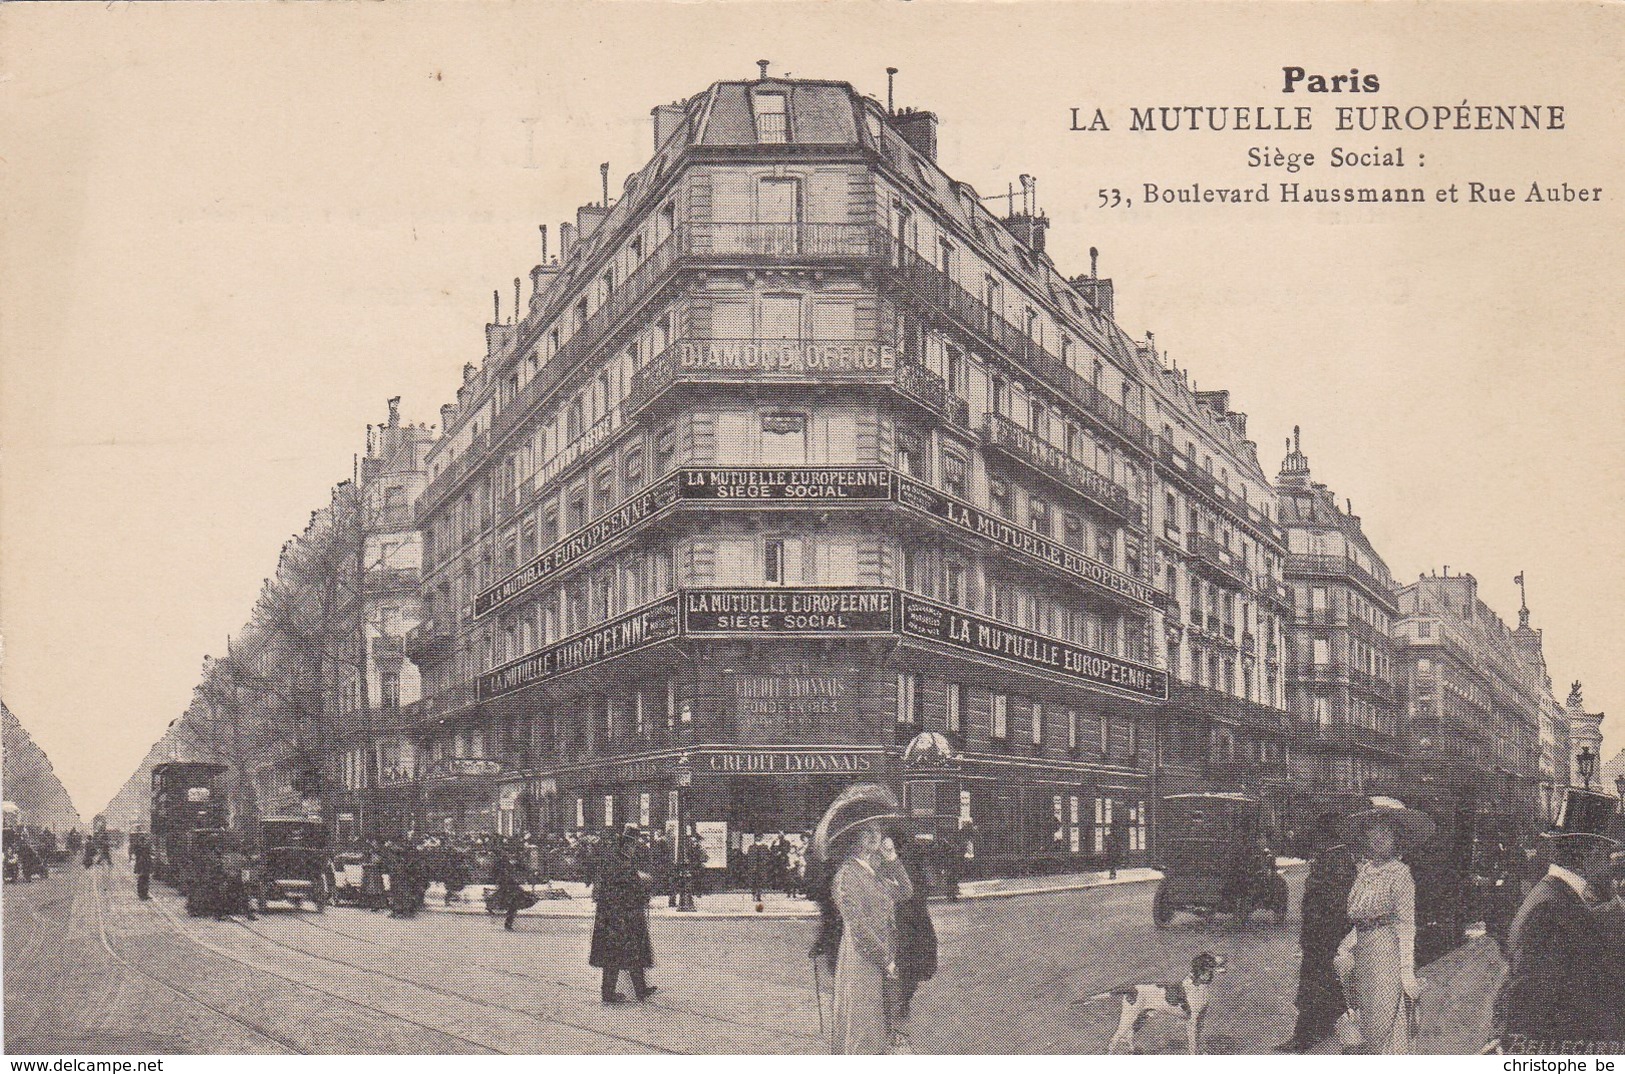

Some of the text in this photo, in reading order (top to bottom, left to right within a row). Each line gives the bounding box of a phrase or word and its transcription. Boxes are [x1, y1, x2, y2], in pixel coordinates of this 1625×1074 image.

[805, 345, 895, 370] OFFICE
[687, 471, 889, 486] LA MUTUELLE EUROPEENNE
[717, 485, 848, 497] SIEGE SOCIAL
[555, 494, 652, 568] EUROPEENNE
[947, 502, 1154, 605] LA MUTUELLE EUROPEENNE
[689, 594, 889, 612] LA MUTUELLE EUROPEENNE
[717, 615, 847, 628] SIEGE SOCIAL
[950, 615, 971, 643] LA
[978, 624, 1060, 666] MUTUELLE
[1064, 649, 1152, 691] EUROPEENNE
[785, 754, 870, 771] LYONNAIS
